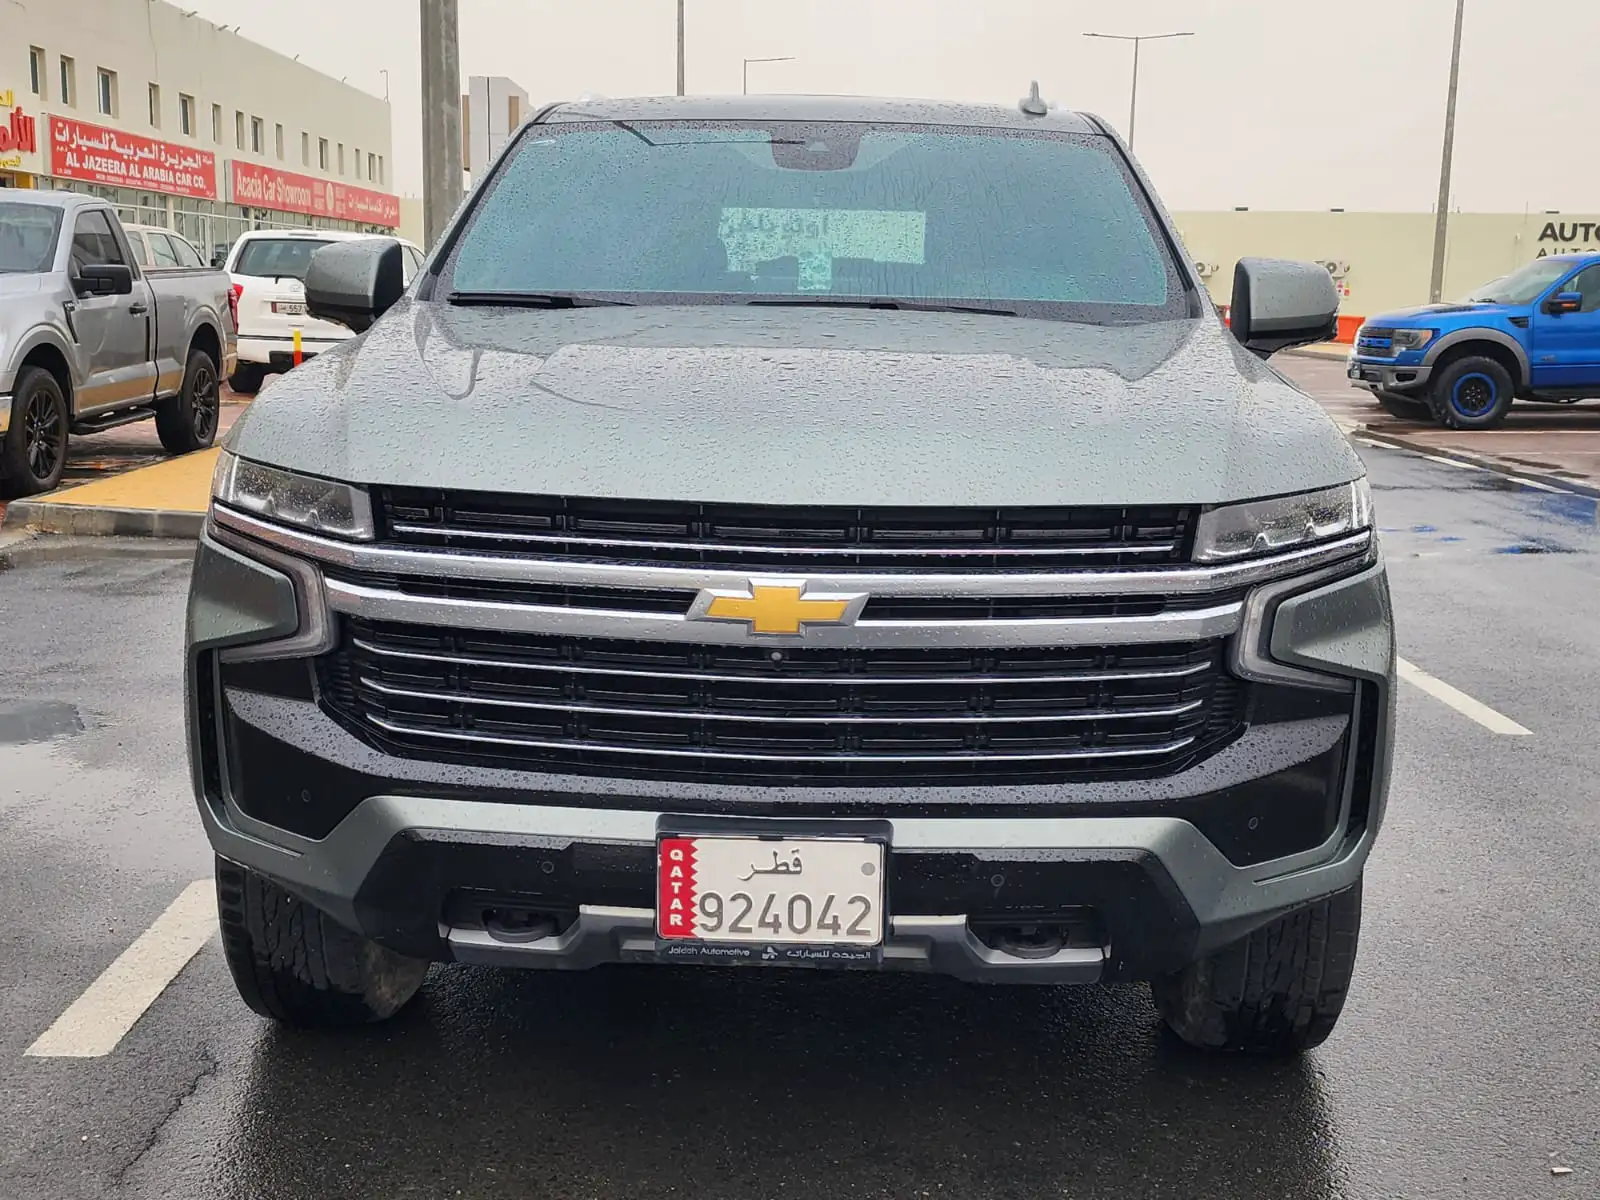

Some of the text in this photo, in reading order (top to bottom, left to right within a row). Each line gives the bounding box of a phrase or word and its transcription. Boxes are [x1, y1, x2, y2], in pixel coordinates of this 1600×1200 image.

[55, 122, 109, 151] للسيارات
[110, 133, 159, 161] العربية
[66, 151, 80, 168] AL
[82, 154, 127, 176] JAZEERA
[128, 163, 141, 178] AL
[143, 165, 175, 184] ARABIA
[175, 172, 193, 187] CAR
[161, 144, 202, 171] الجزيرة
[236, 167, 262, 200] Acacia
[263, 173, 276, 201] Car
[277, 176, 312, 207] Showroom
[1537, 222, 1600, 242] AUT
[738, 848, 803, 882] قطر
[669, 849, 684, 926] QATAR
[700, 891, 872, 936] 924042
[700, 947, 750, 957] Automotive
